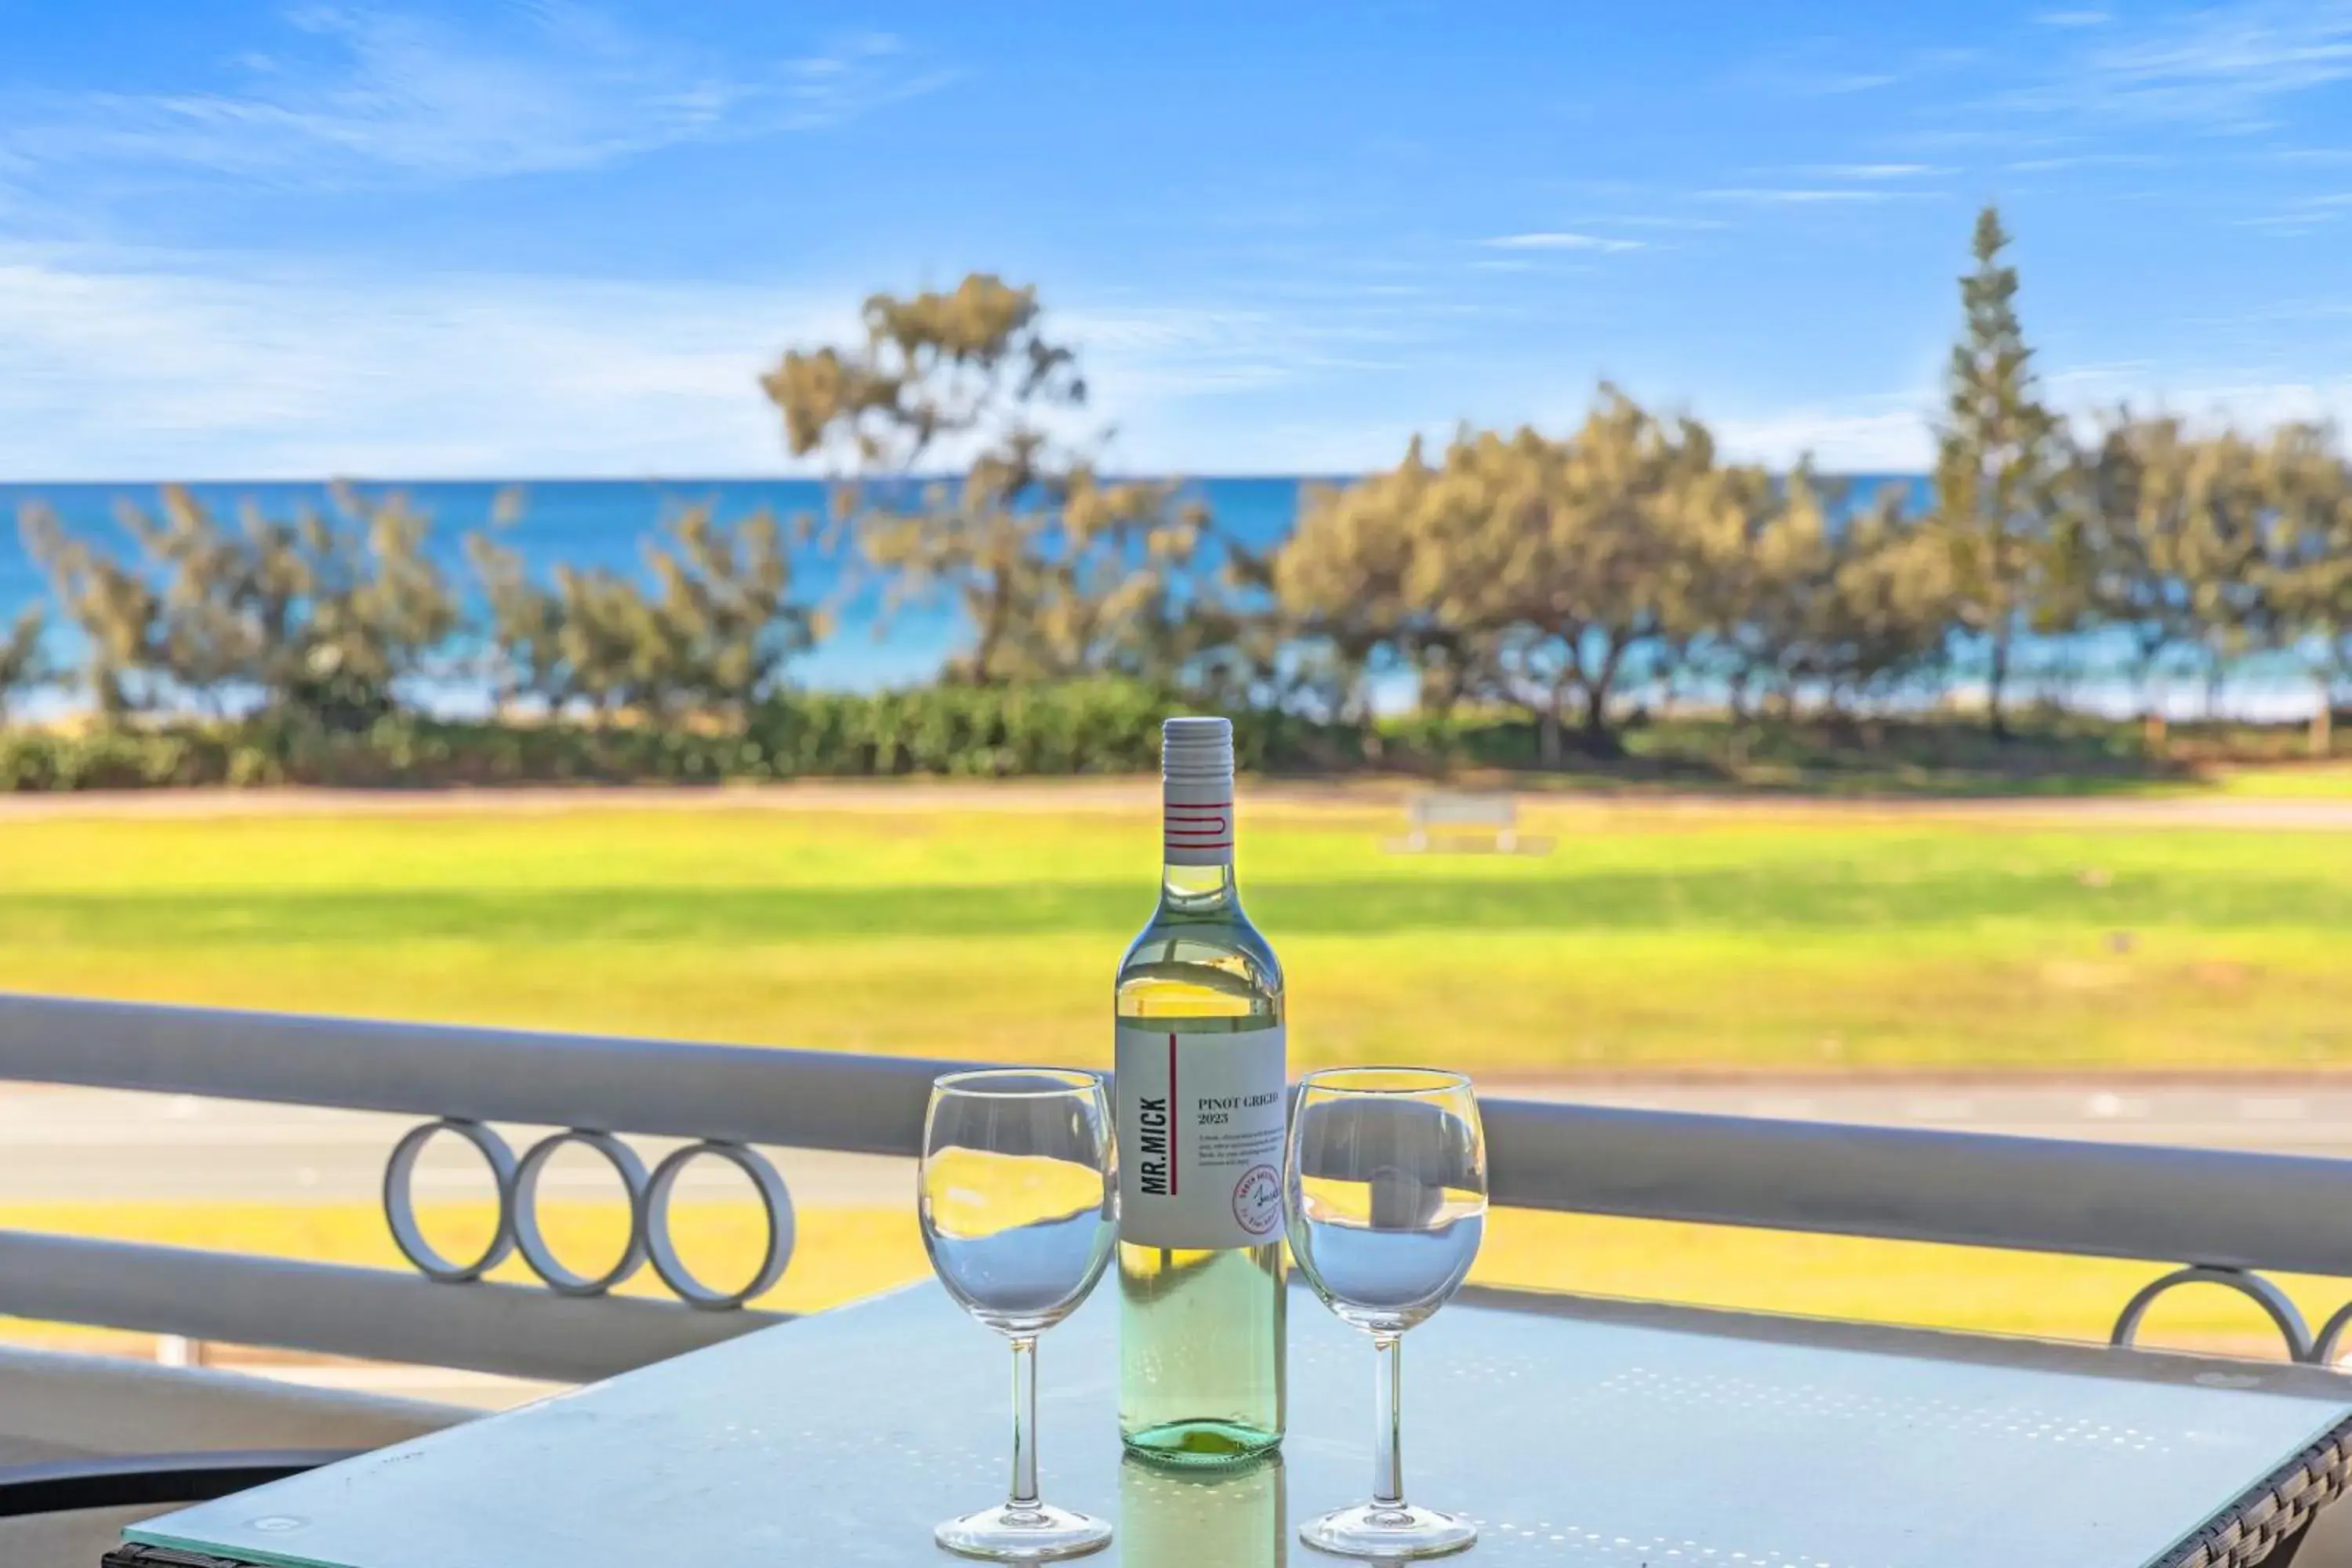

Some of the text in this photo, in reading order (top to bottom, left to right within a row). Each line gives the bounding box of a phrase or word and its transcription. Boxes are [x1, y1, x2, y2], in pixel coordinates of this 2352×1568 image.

[1198, 1098, 1240, 1110] PINOT
[1198, 1113, 1229, 1125] 2023
[1140, 1097, 1167, 1196] MR.MICK
